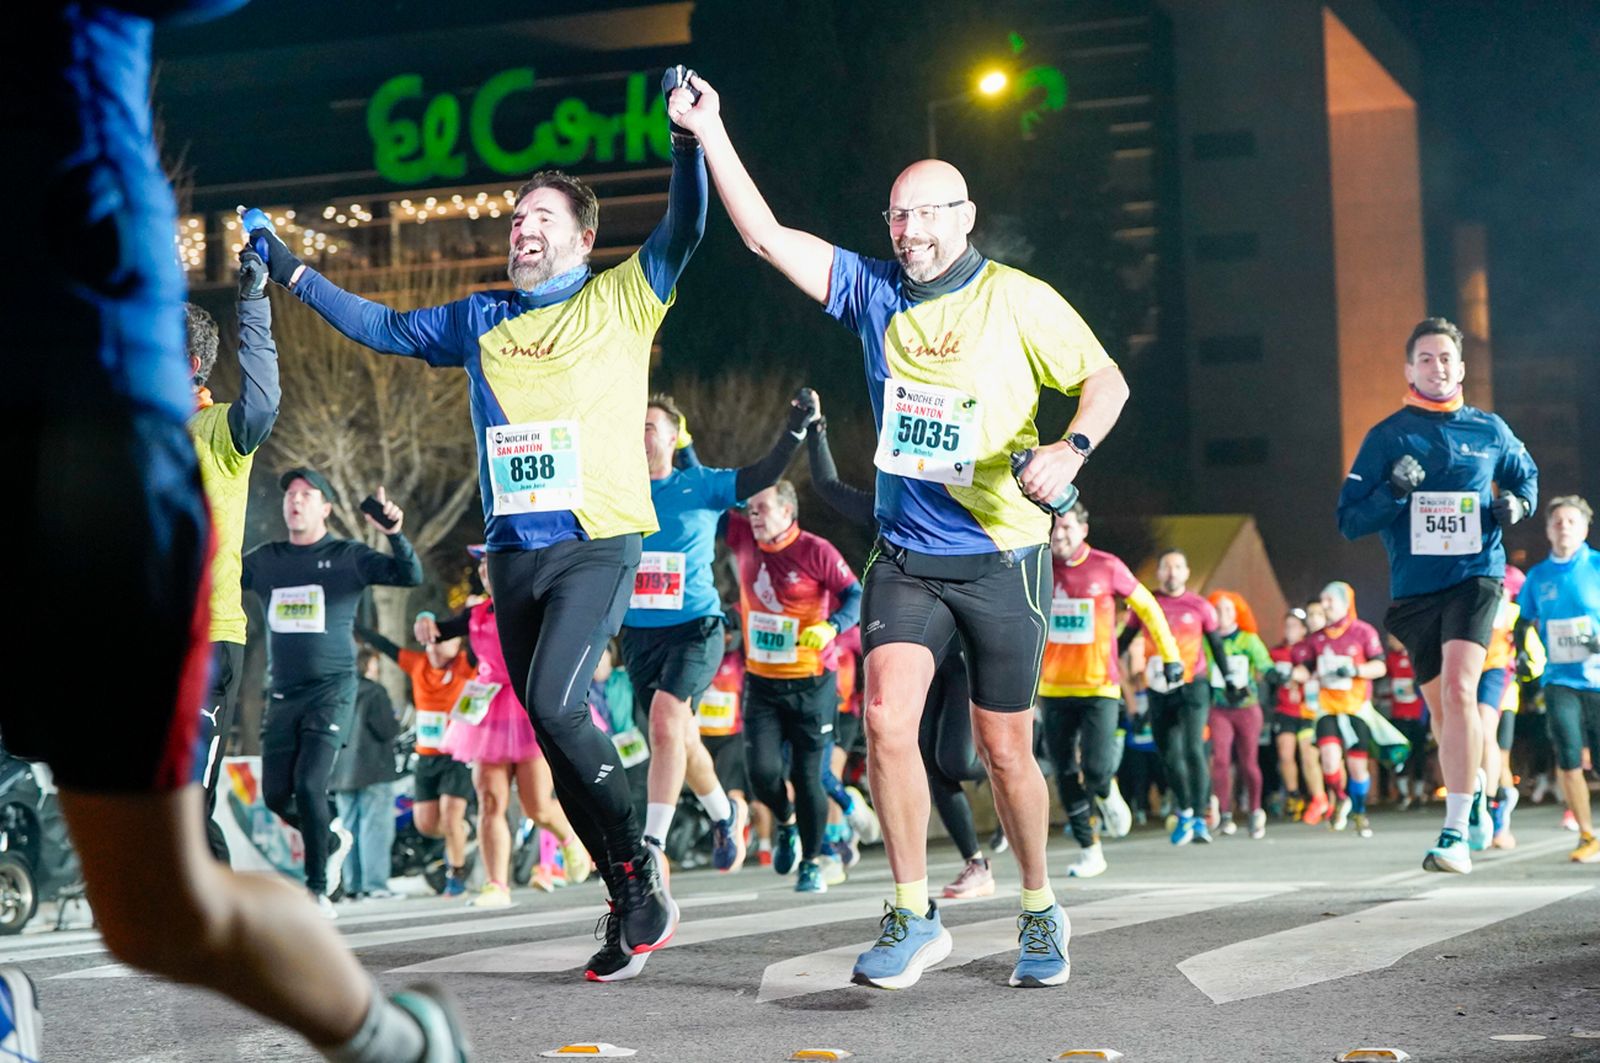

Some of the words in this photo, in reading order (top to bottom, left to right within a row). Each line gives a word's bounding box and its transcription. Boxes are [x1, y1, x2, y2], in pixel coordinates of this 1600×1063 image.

[367, 73, 467, 183] El
[896, 402, 912, 414] SAN
[907, 393, 932, 405] NOCHE
[934, 398, 945, 407] DE
[504, 433, 529, 443] NOCHE
[898, 415, 960, 451] 5035
[496, 446, 512, 456] SAN
[510, 454, 555, 483] 838
[1426, 515, 1467, 533] 5451
[756, 630, 785, 648] 7470
